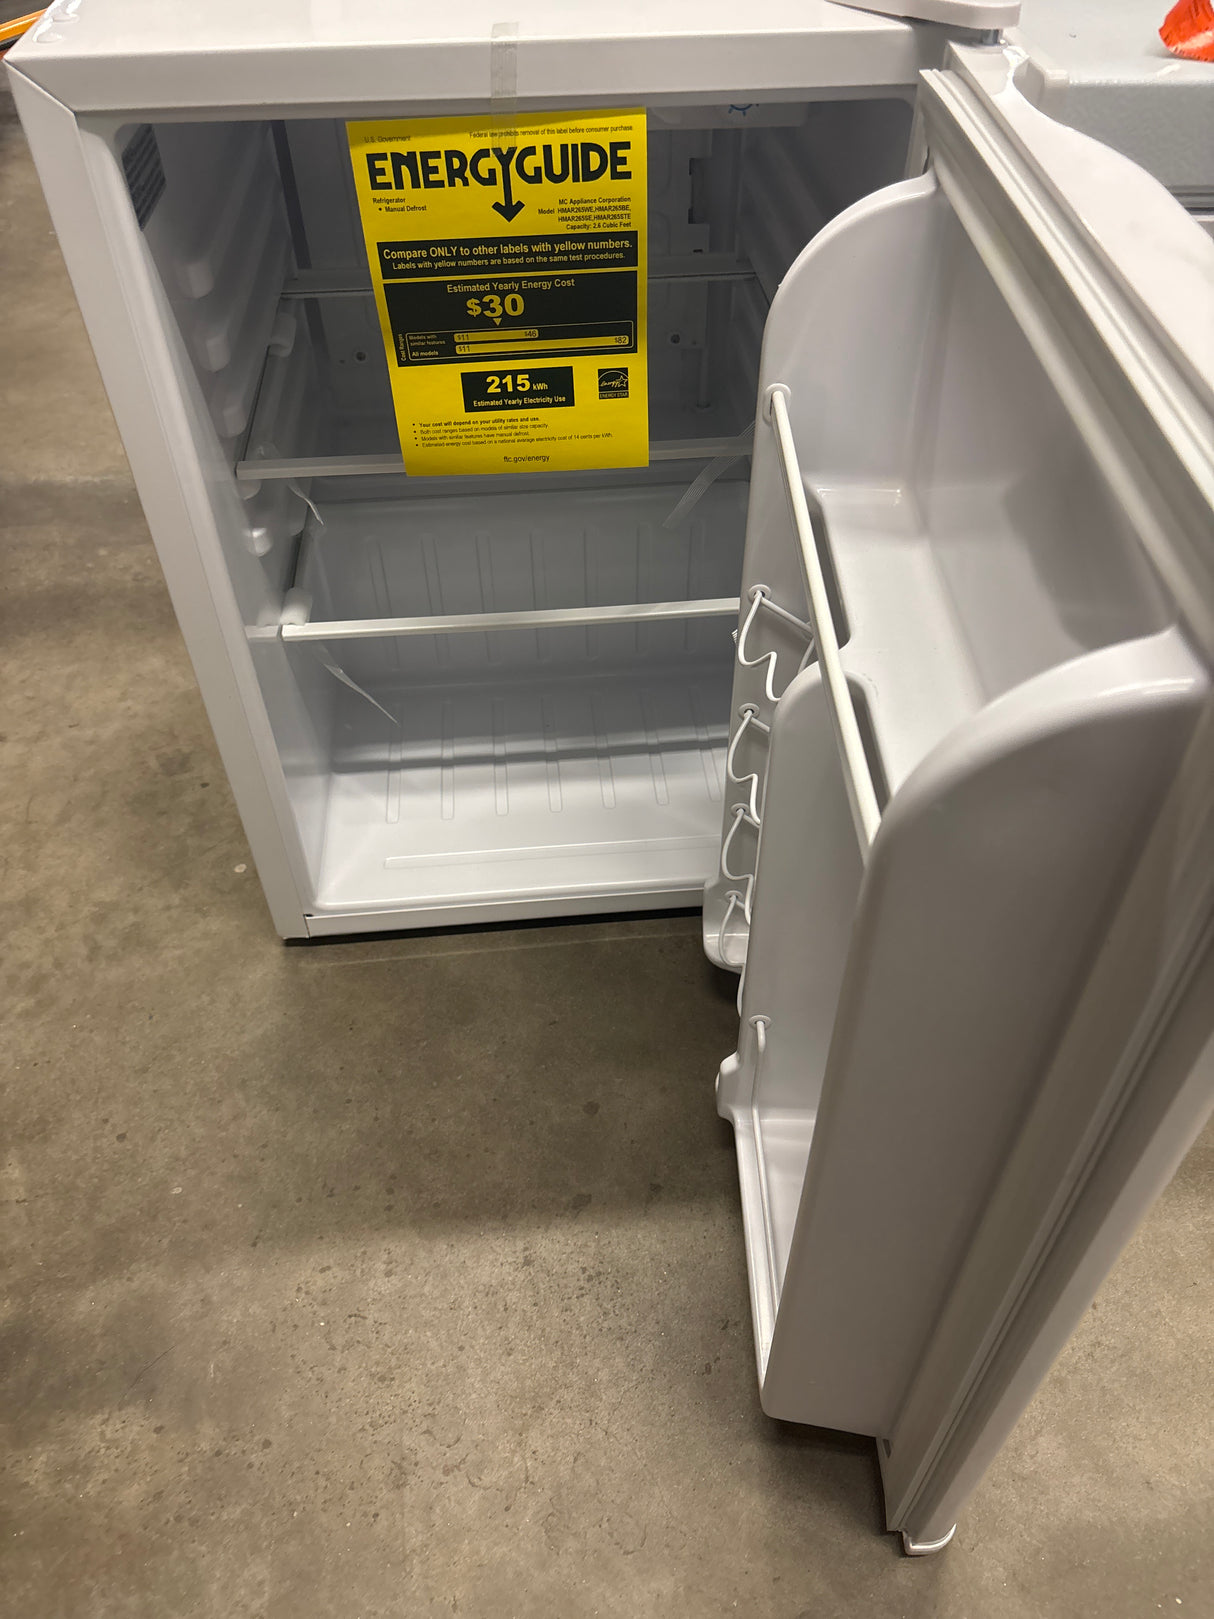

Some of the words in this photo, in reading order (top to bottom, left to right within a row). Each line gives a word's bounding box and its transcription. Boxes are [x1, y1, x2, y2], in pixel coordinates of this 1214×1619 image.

[499, 130, 519, 138] prohibits
[366, 141, 632, 191] ENERGYGUIDE
[372, 197, 406, 205] Refrigerator
[570, 198, 597, 206] Appliance
[598, 196, 632, 204] Corporation
[383, 248, 428, 260] Compare
[429, 246, 458, 257] ONLY
[460, 246, 470, 256] to
[472, 244, 498, 256] other
[500, 243, 529, 254] labels
[531, 242, 552, 252] with
[554, 240, 586, 254] yellow
[588, 238, 632, 250] numbers.
[392, 262, 416, 270] Labels
[418, 260, 432, 268] with
[433, 260, 456, 270] yellow
[458, 258, 488, 267] numbers
[502, 256, 524, 264] based
[584, 252, 625, 262] procedures.
[446, 282, 490, 293] Estimated
[492, 280, 519, 292] Yearly
[522, 280, 552, 290] Energy
[554, 278, 575, 287] Cost
[466, 293, 525, 318] $30
[486, 374, 530, 394] 215
[532, 382, 548, 390] kWh
[473, 399, 502, 407] Estimated
[504, 398, 522, 406] Yearly
[504, 455, 550, 464] ftc.gov/energy
